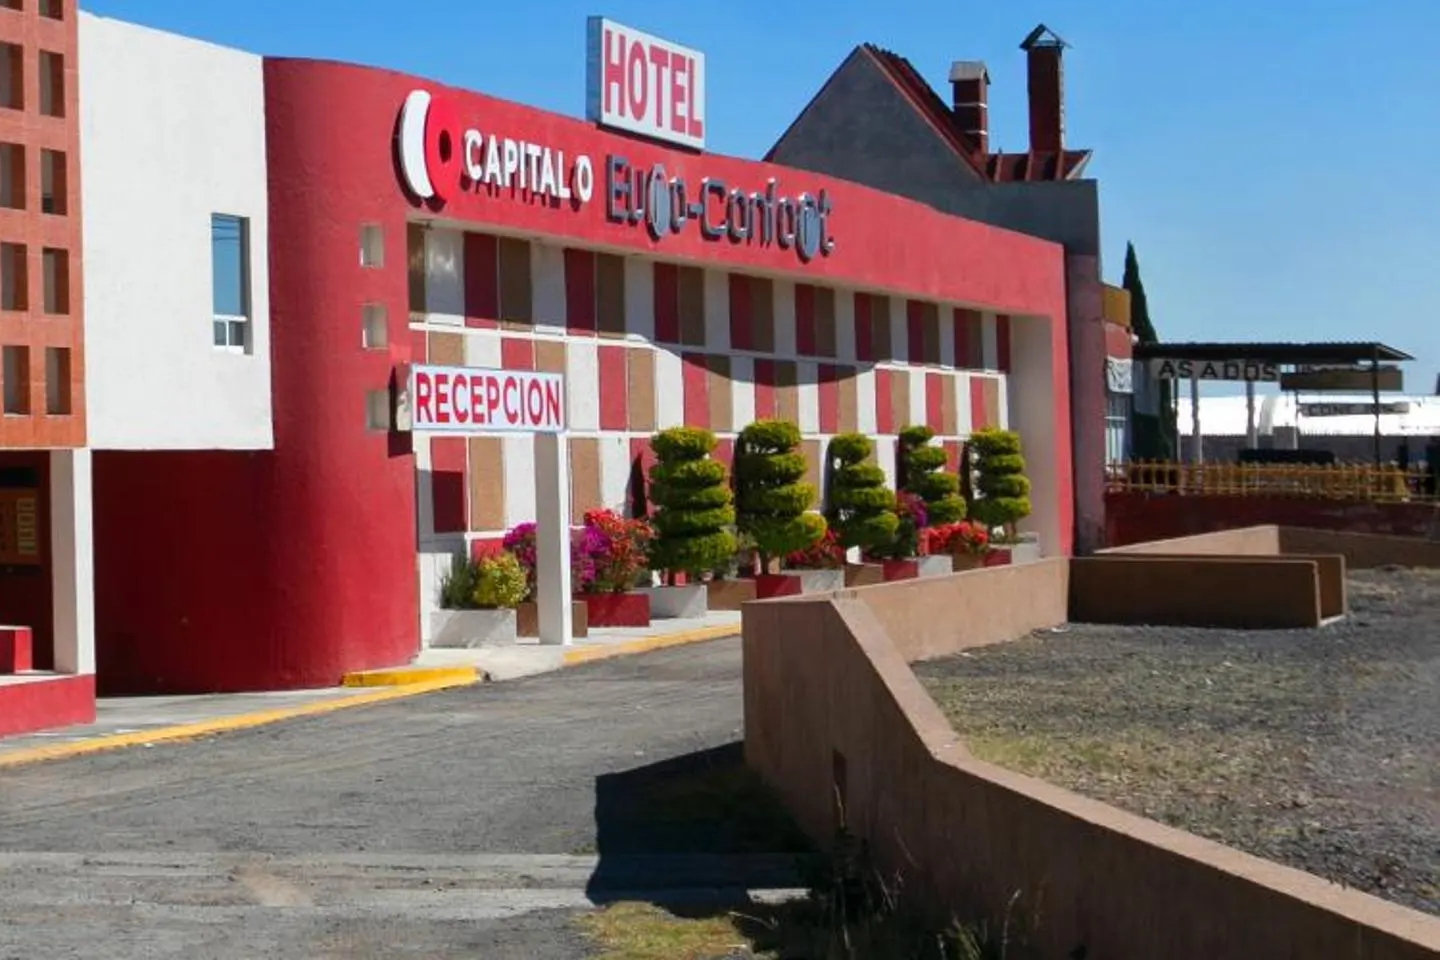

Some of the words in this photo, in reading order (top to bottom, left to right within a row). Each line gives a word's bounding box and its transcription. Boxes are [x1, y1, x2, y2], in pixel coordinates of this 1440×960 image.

[604, 29, 703, 139] HOTEL
[465, 128, 570, 200] CAPITAL
[572, 154, 594, 204] O
[416, 372, 560, 426] RECEPCION
[1158, 359, 1279, 382] ASADOS
